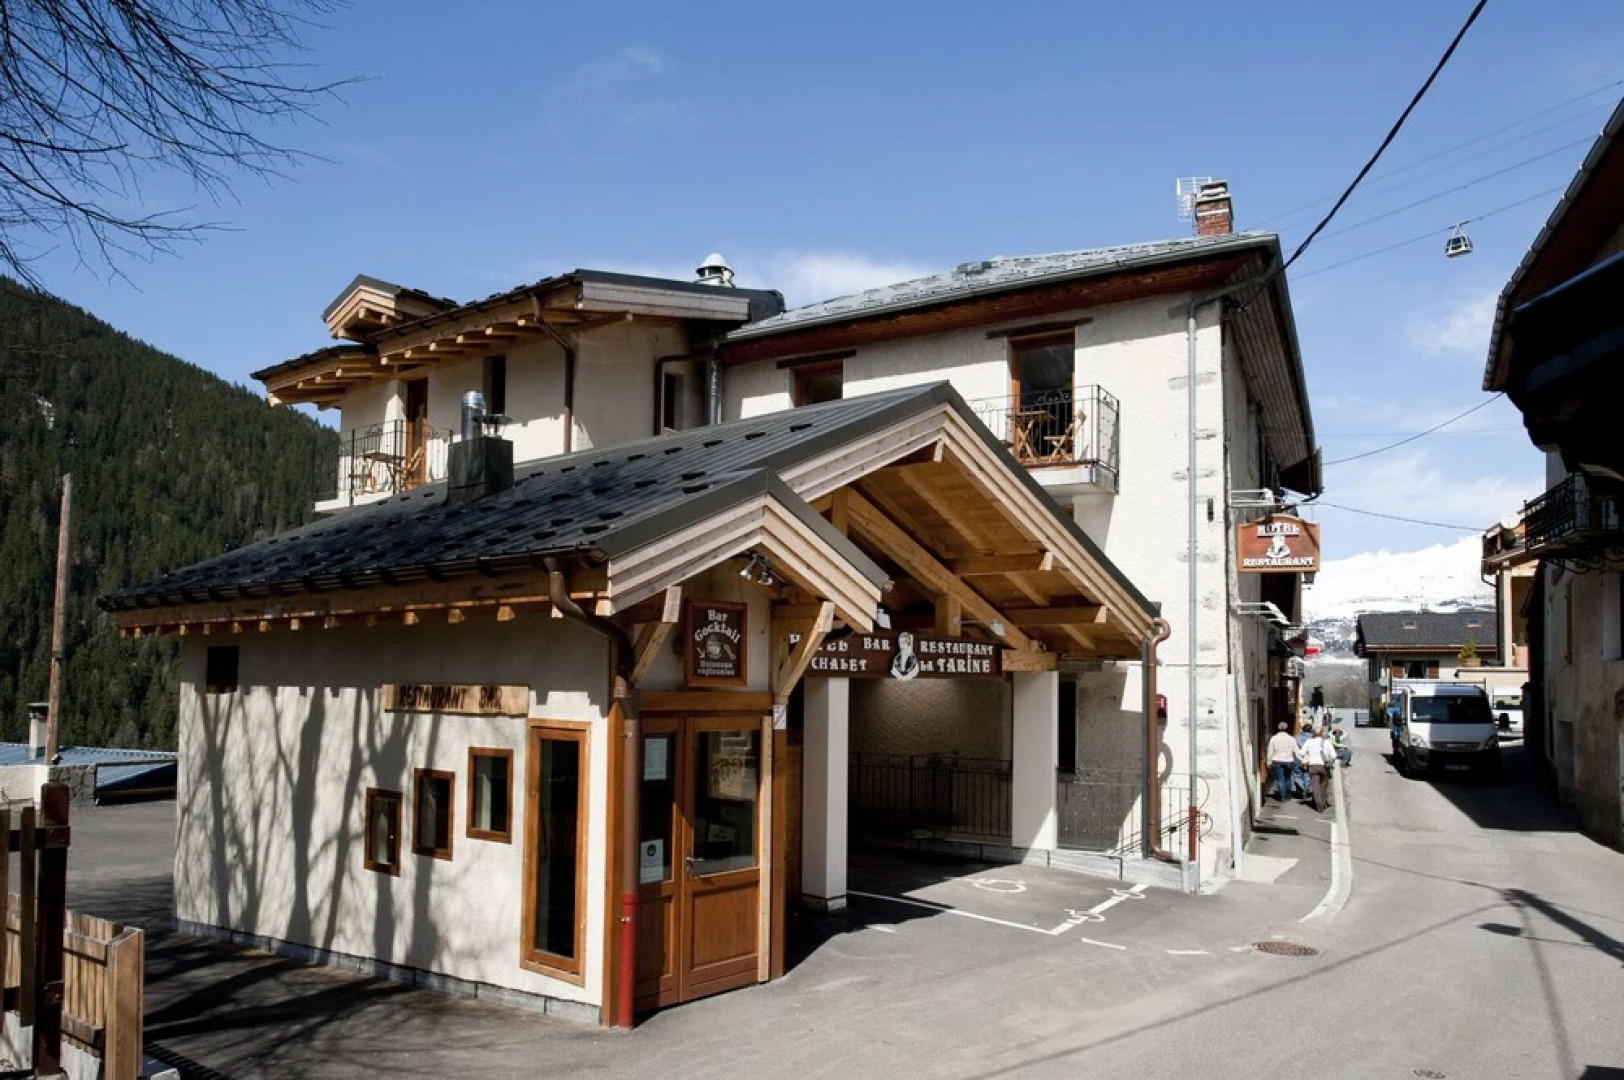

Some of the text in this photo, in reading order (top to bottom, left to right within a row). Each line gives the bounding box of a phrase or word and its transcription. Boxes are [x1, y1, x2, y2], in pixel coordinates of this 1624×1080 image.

[1243, 556, 1315, 567] RESTAURANT
[707, 609, 728, 621] Bar
[694, 621, 741, 644] Cocktail
[863, 637, 891, 650] BAR
[920, 640, 995, 656] RESTAURANT
[811, 657, 868, 671] CHALET
[937, 654, 991, 673] TARINE
[398, 684, 502, 710] RESTAURANT BAR
